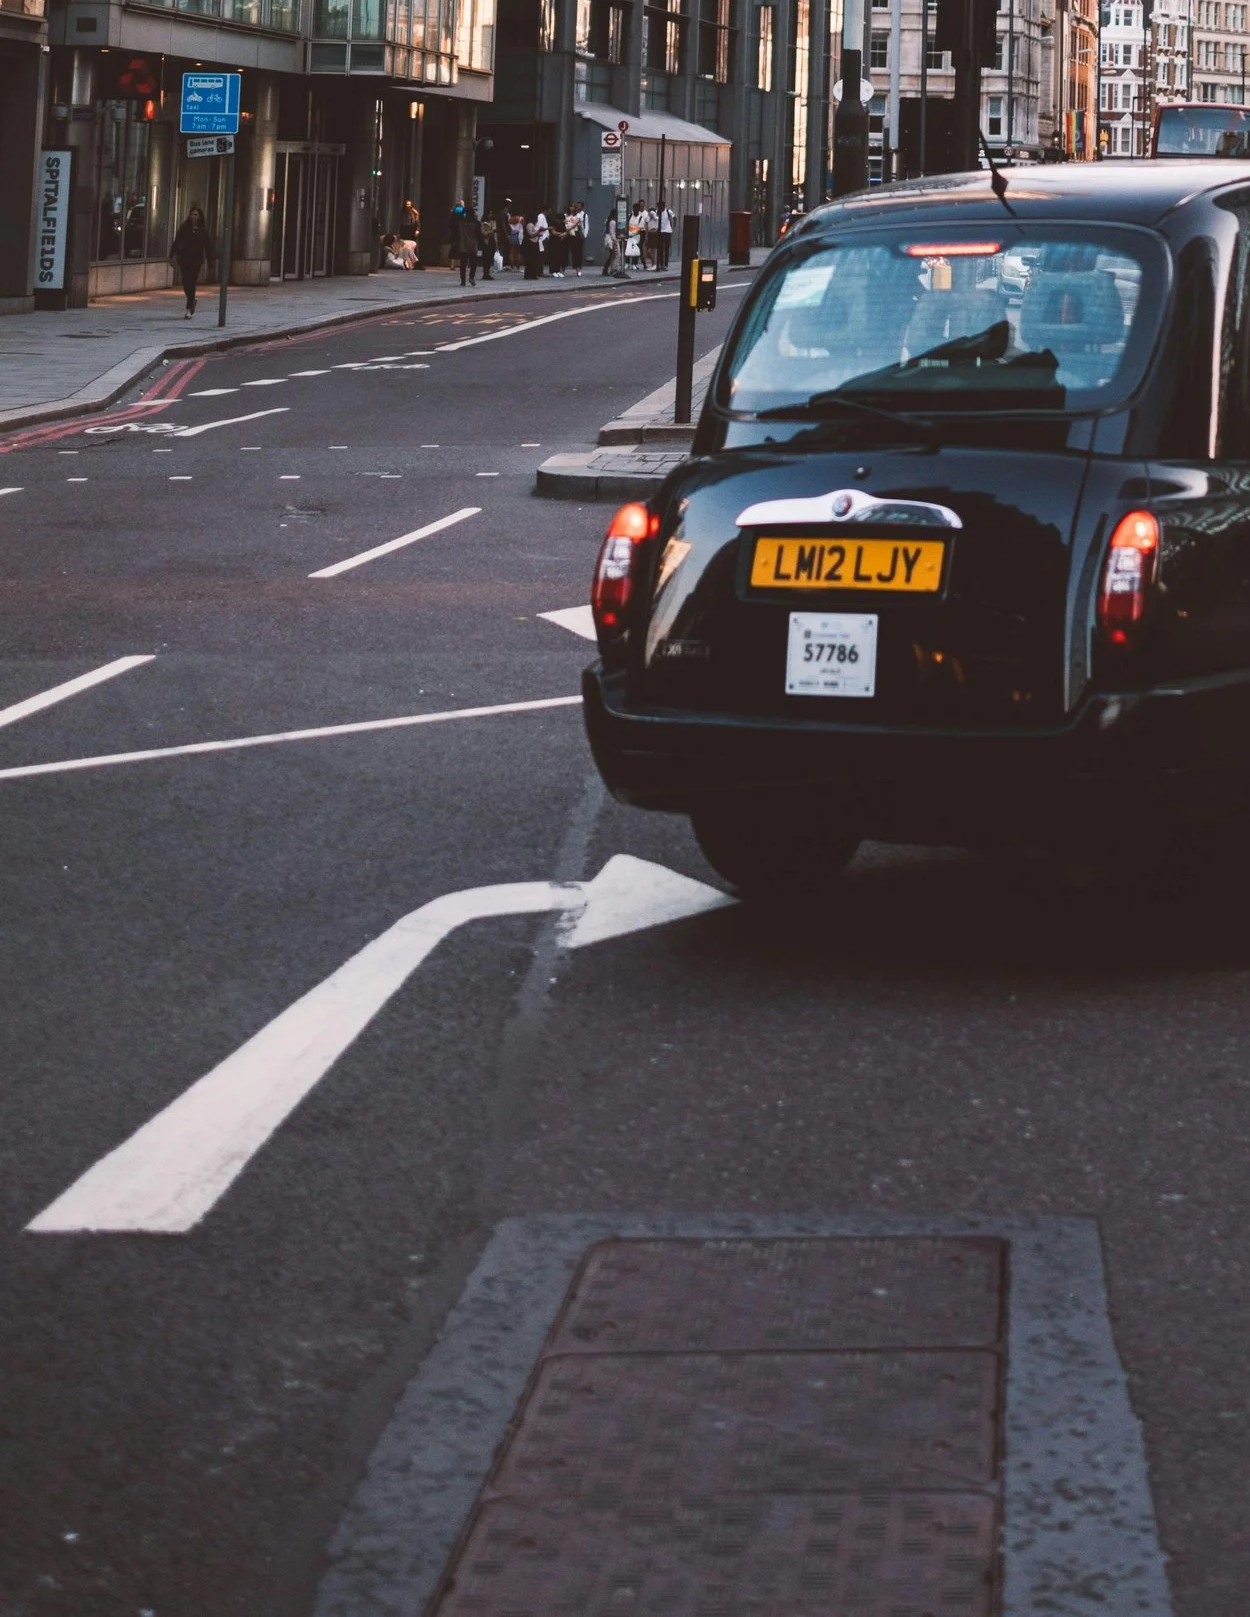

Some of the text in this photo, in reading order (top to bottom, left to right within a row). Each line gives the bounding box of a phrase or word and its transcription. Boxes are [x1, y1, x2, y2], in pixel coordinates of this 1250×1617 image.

[773, 544, 922, 584] LM12 LJY
[803, 642, 859, 664] 57786
